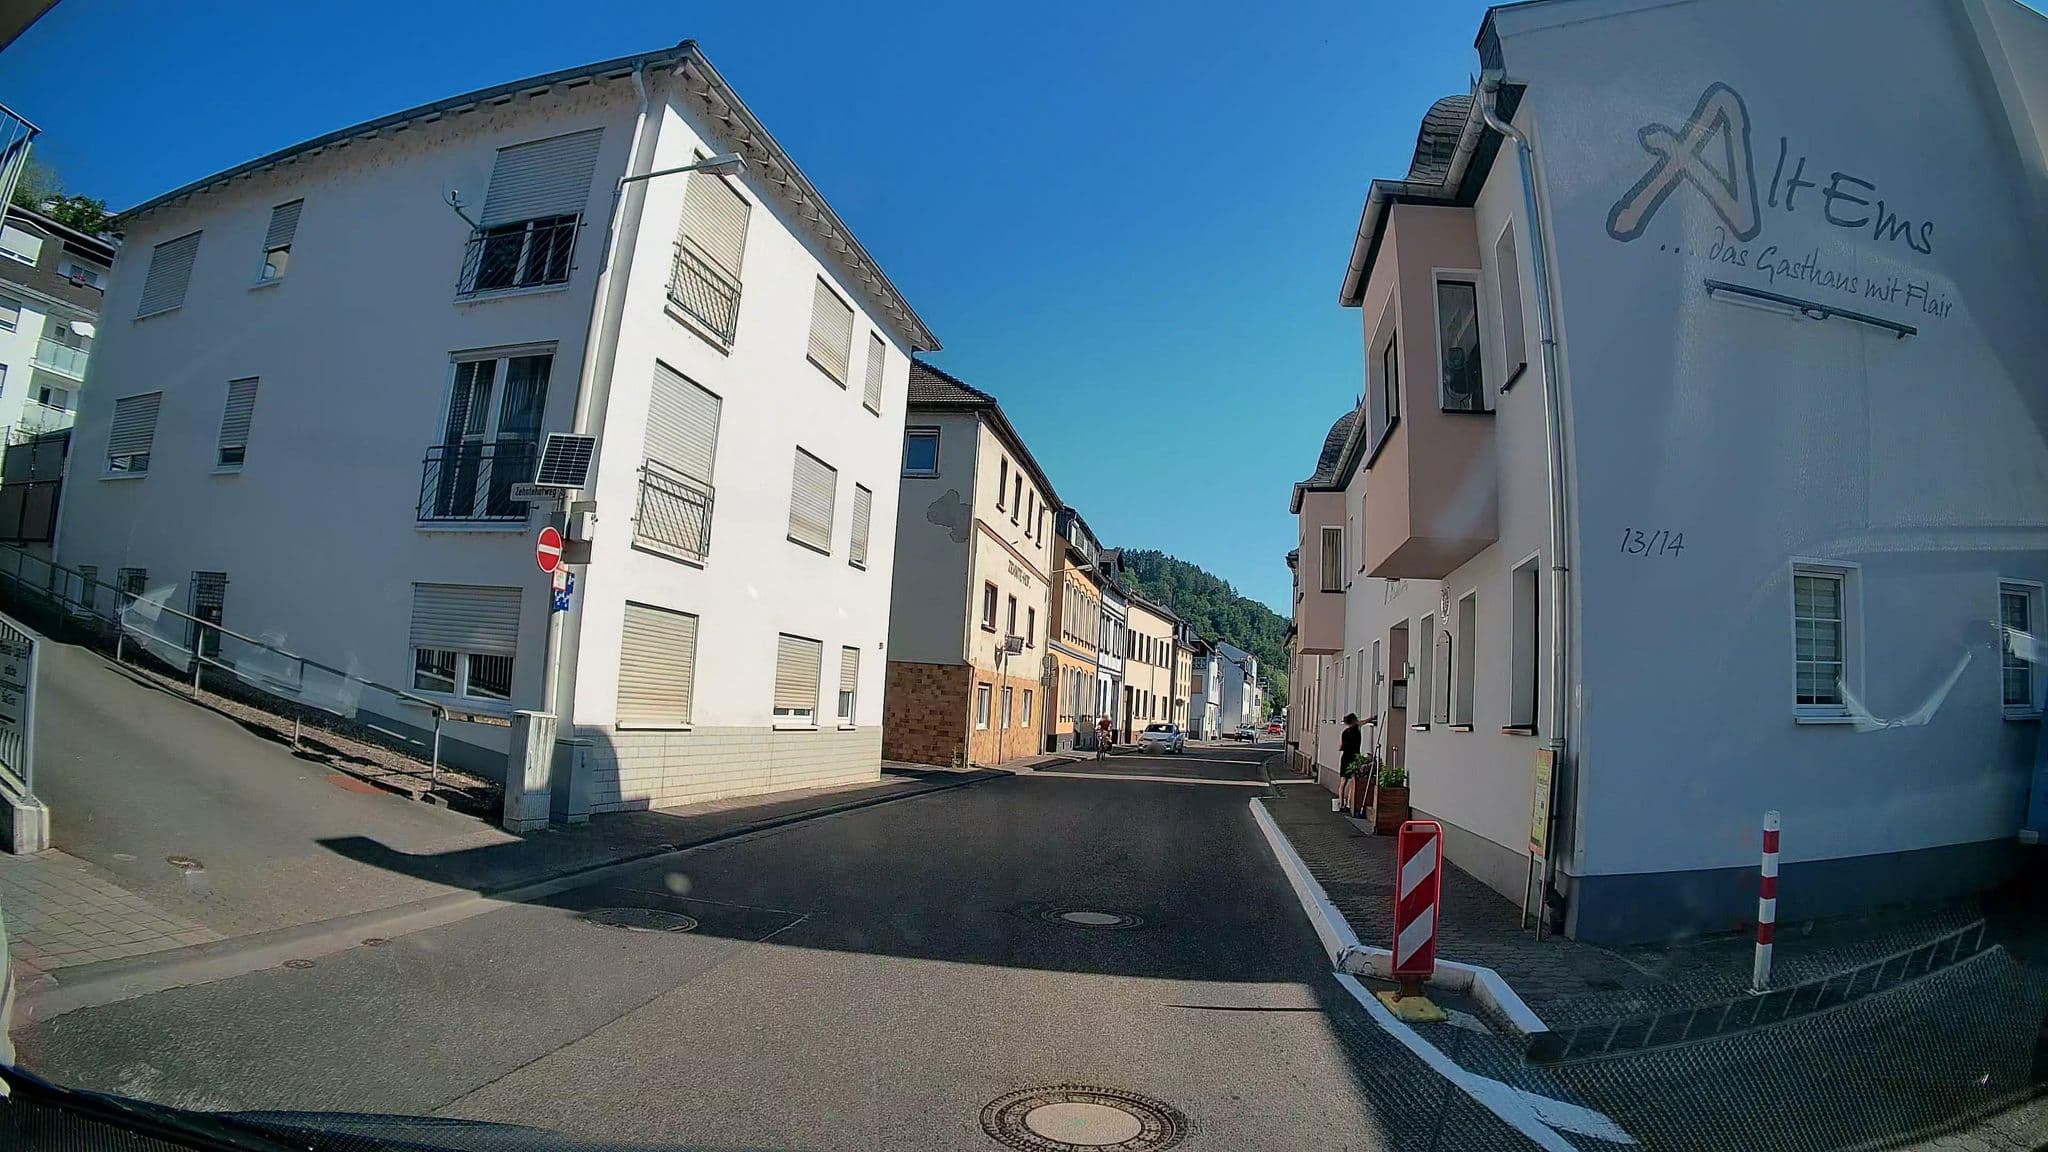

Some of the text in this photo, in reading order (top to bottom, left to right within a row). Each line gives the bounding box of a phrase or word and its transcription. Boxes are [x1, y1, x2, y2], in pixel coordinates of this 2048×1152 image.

[1823, 171, 1935, 255] Ems
[1709, 227, 1748, 268] das
[1756, 247, 1858, 295] Gasthaus
[1864, 276, 1906, 304] mit
[1906, 282, 1955, 319] Flair
[1620, 527, 1685, 558] 13/14
